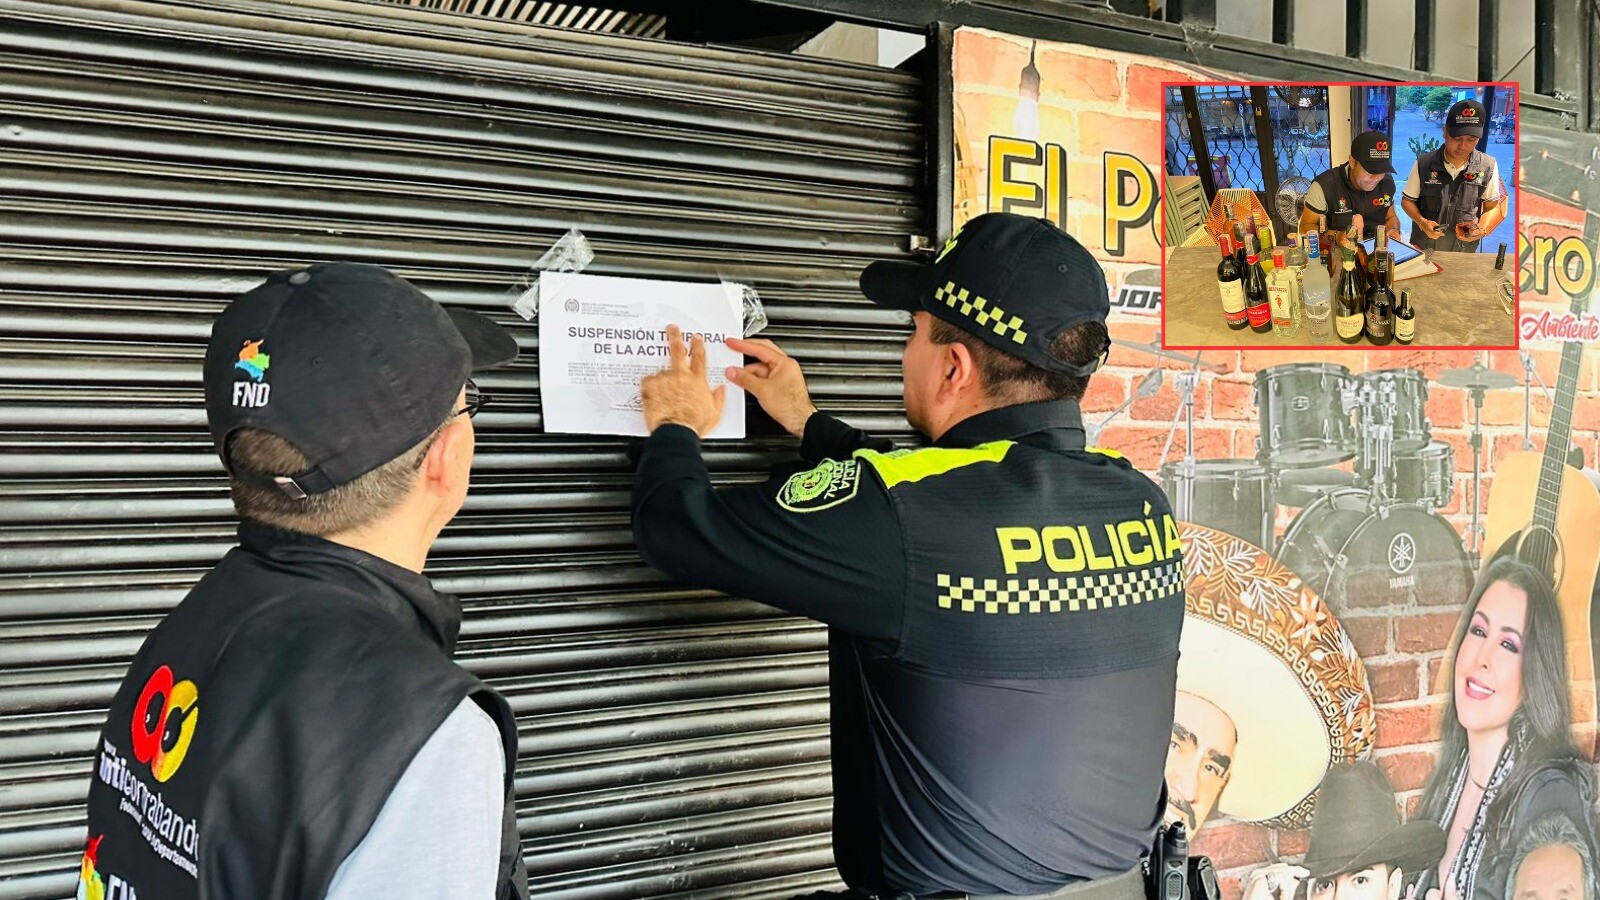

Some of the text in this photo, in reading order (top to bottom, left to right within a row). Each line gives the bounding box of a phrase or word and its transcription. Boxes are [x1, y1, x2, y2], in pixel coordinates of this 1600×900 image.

[568, 326, 655, 342] SUSPENSIÓN
[1521, 311, 1599, 341] Ambiente
[594, 343, 613, 354] DE
[616, 344, 633, 355] LA
[232, 381, 271, 407] FND
[995, 501, 1184, 574] POLICÍA
